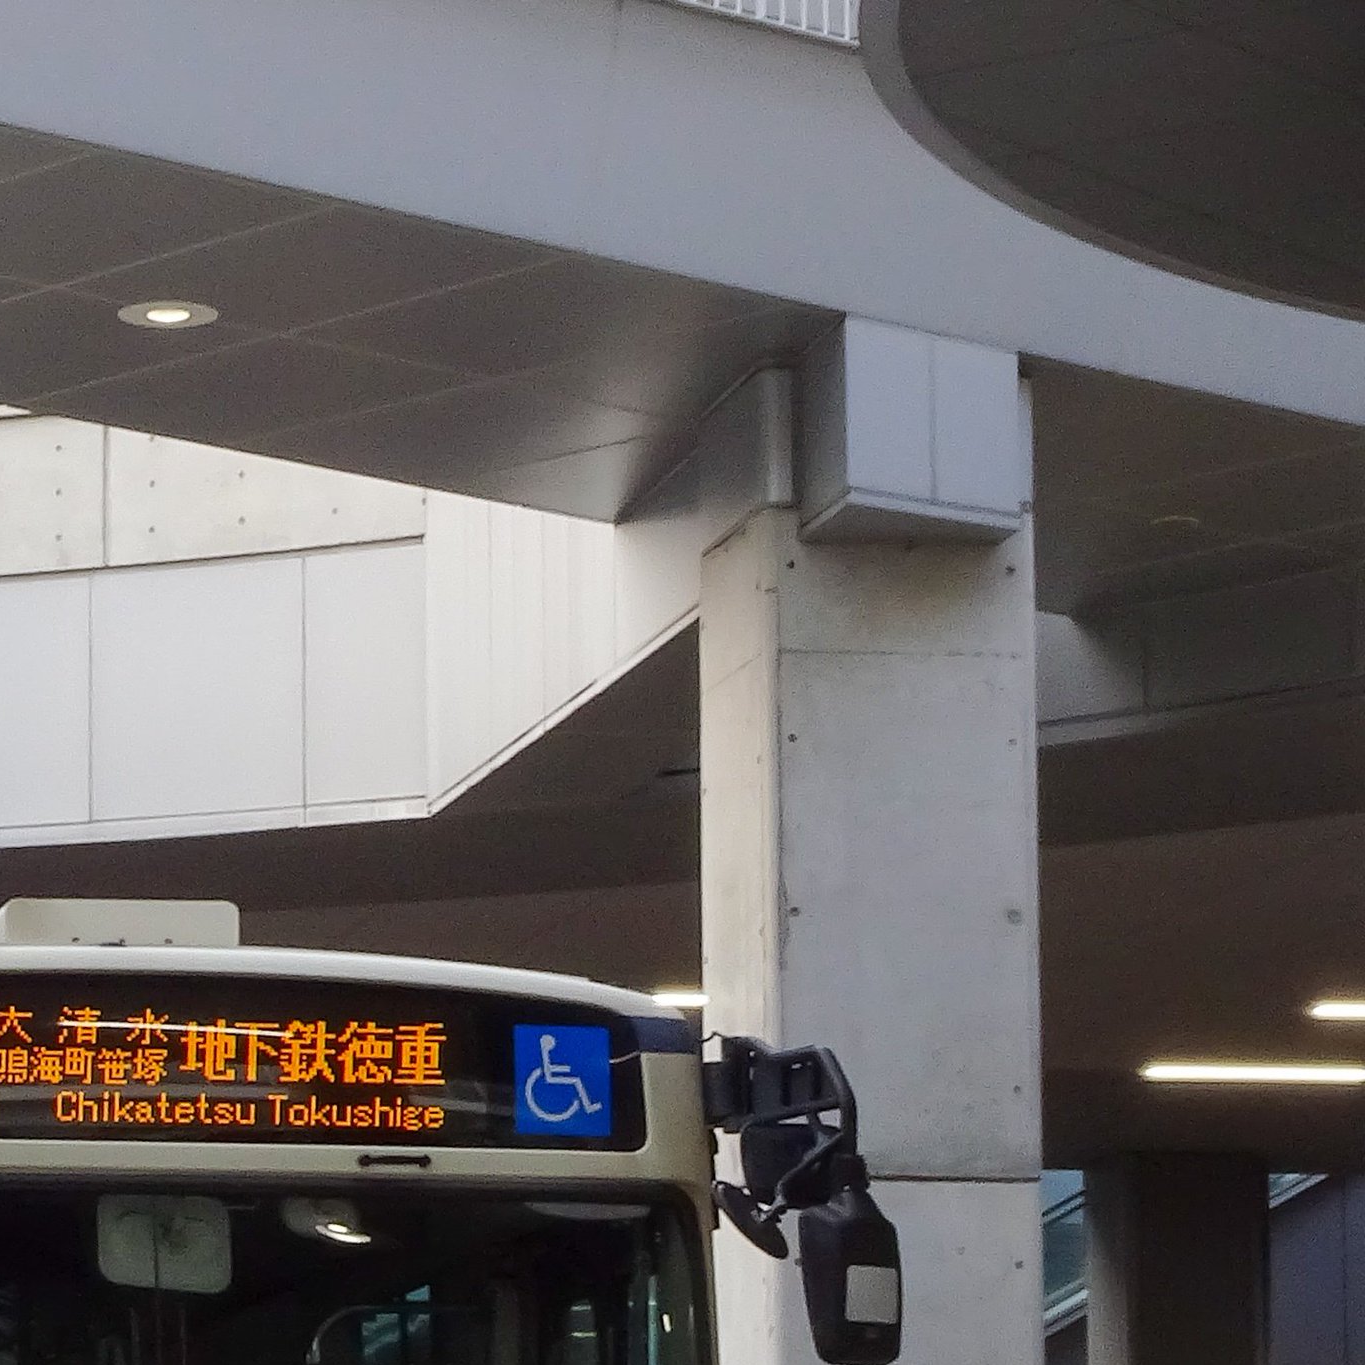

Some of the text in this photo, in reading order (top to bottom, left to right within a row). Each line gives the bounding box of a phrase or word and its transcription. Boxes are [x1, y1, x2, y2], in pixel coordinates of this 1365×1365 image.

[179, 1018, 447, 1086] 地下鉄徳重
[55, 1090, 446, 1131] Chikatetsu Tokushige
